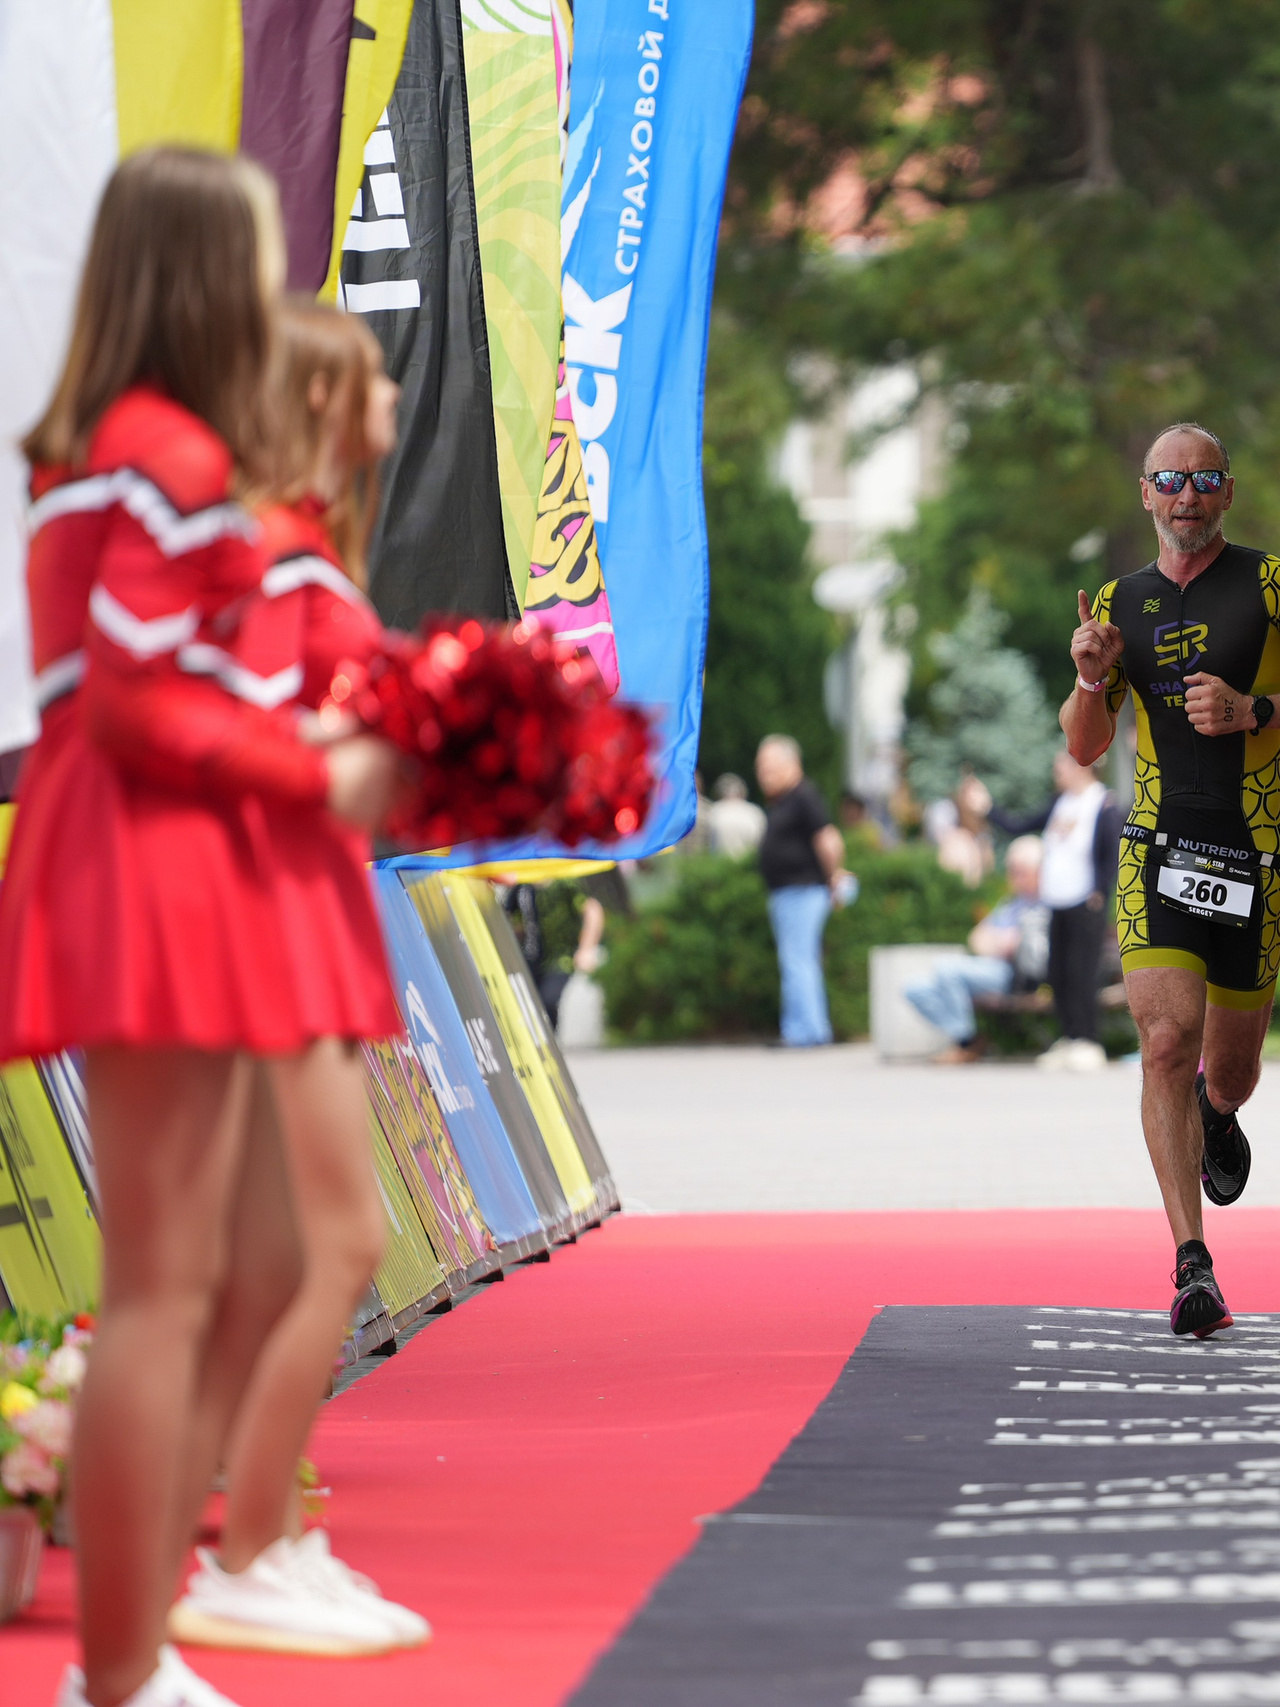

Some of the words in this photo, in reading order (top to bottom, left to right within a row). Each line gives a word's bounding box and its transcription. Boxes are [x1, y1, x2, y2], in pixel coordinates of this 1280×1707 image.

[614, 30, 665, 276] СТРАХОВОЙ
[1149, 680, 1187, 695] SHA
[1163, 694, 1185, 708] TE
[1224, 698, 1235, 723] 260
[1177, 837, 1250, 861] NUTREND
[1179, 876, 1228, 907] 260
[1188, 906, 1214, 918] SERGEY
